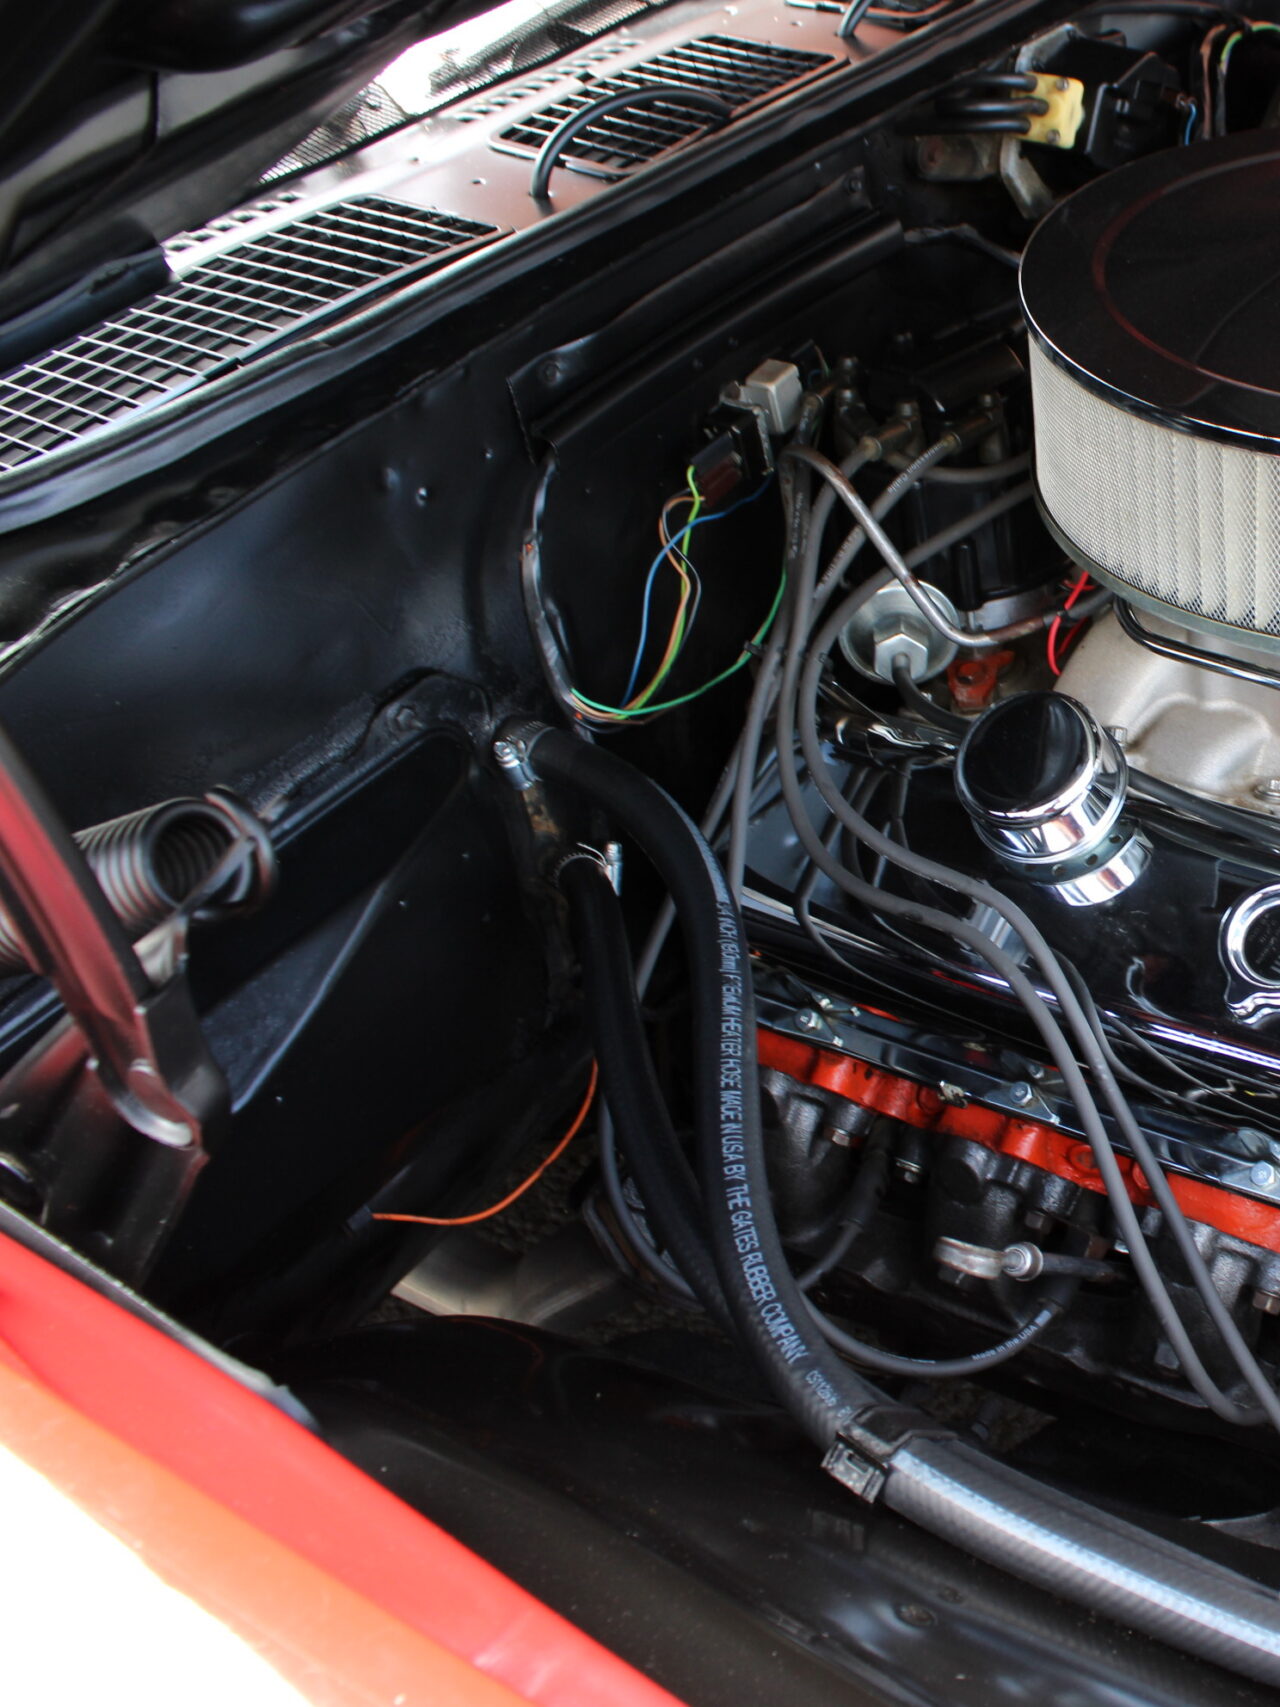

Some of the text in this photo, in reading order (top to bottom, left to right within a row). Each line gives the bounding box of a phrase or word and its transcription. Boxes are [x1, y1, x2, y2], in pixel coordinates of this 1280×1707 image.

[720, 1016, 743, 1059] HEATER
[720, 1059, 742, 1089] HOSE
[720, 1090, 743, 1121] MADE
[723, 1164, 747, 1181] BY
[726, 1183, 751, 1211] THE
[730, 1210, 760, 1254] GATES
[740, 1251, 777, 1307] RUBBER
[760, 1302, 810, 1365] COMPANY
[1018, 1324, 1038, 1341] USA
